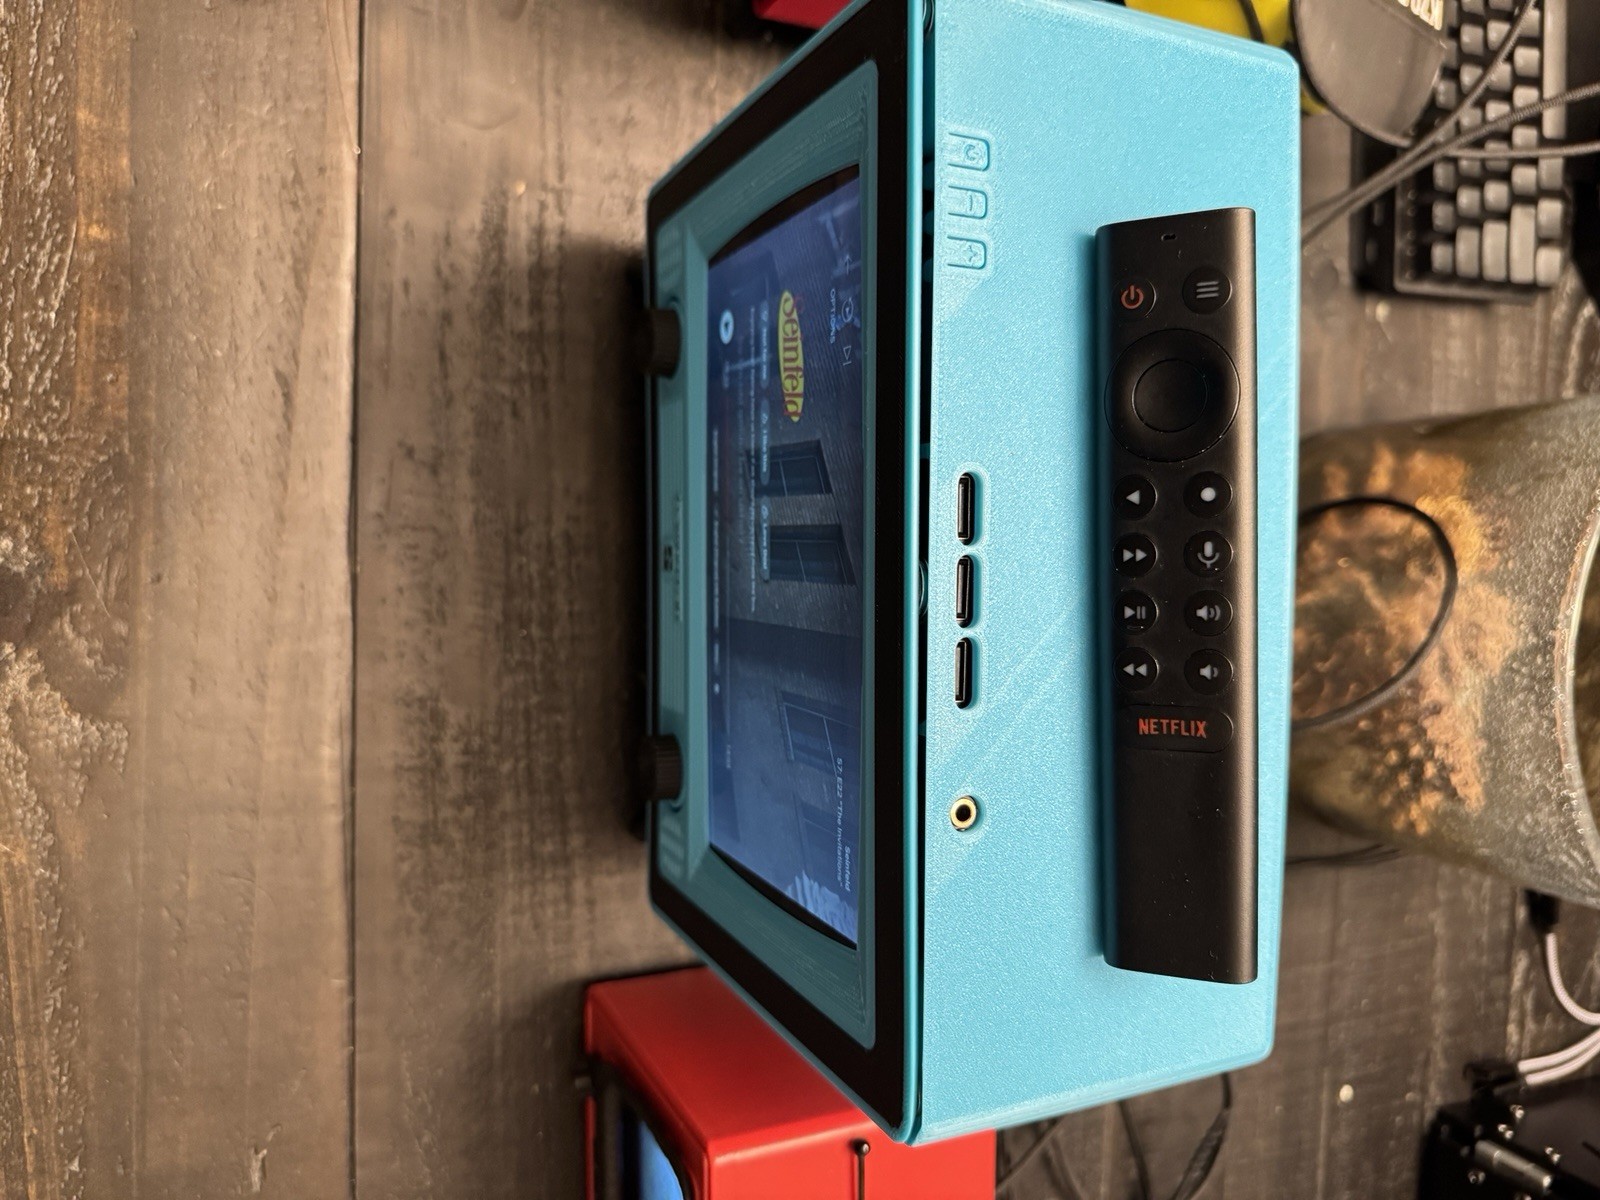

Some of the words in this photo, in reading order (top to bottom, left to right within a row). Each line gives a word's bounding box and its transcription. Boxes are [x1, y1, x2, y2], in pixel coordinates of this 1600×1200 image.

[782, 296, 805, 417] Seinfeld
[1137, 718, 1207, 739] NETFLIX
[844, 845, 852, 892] Seinfeld
